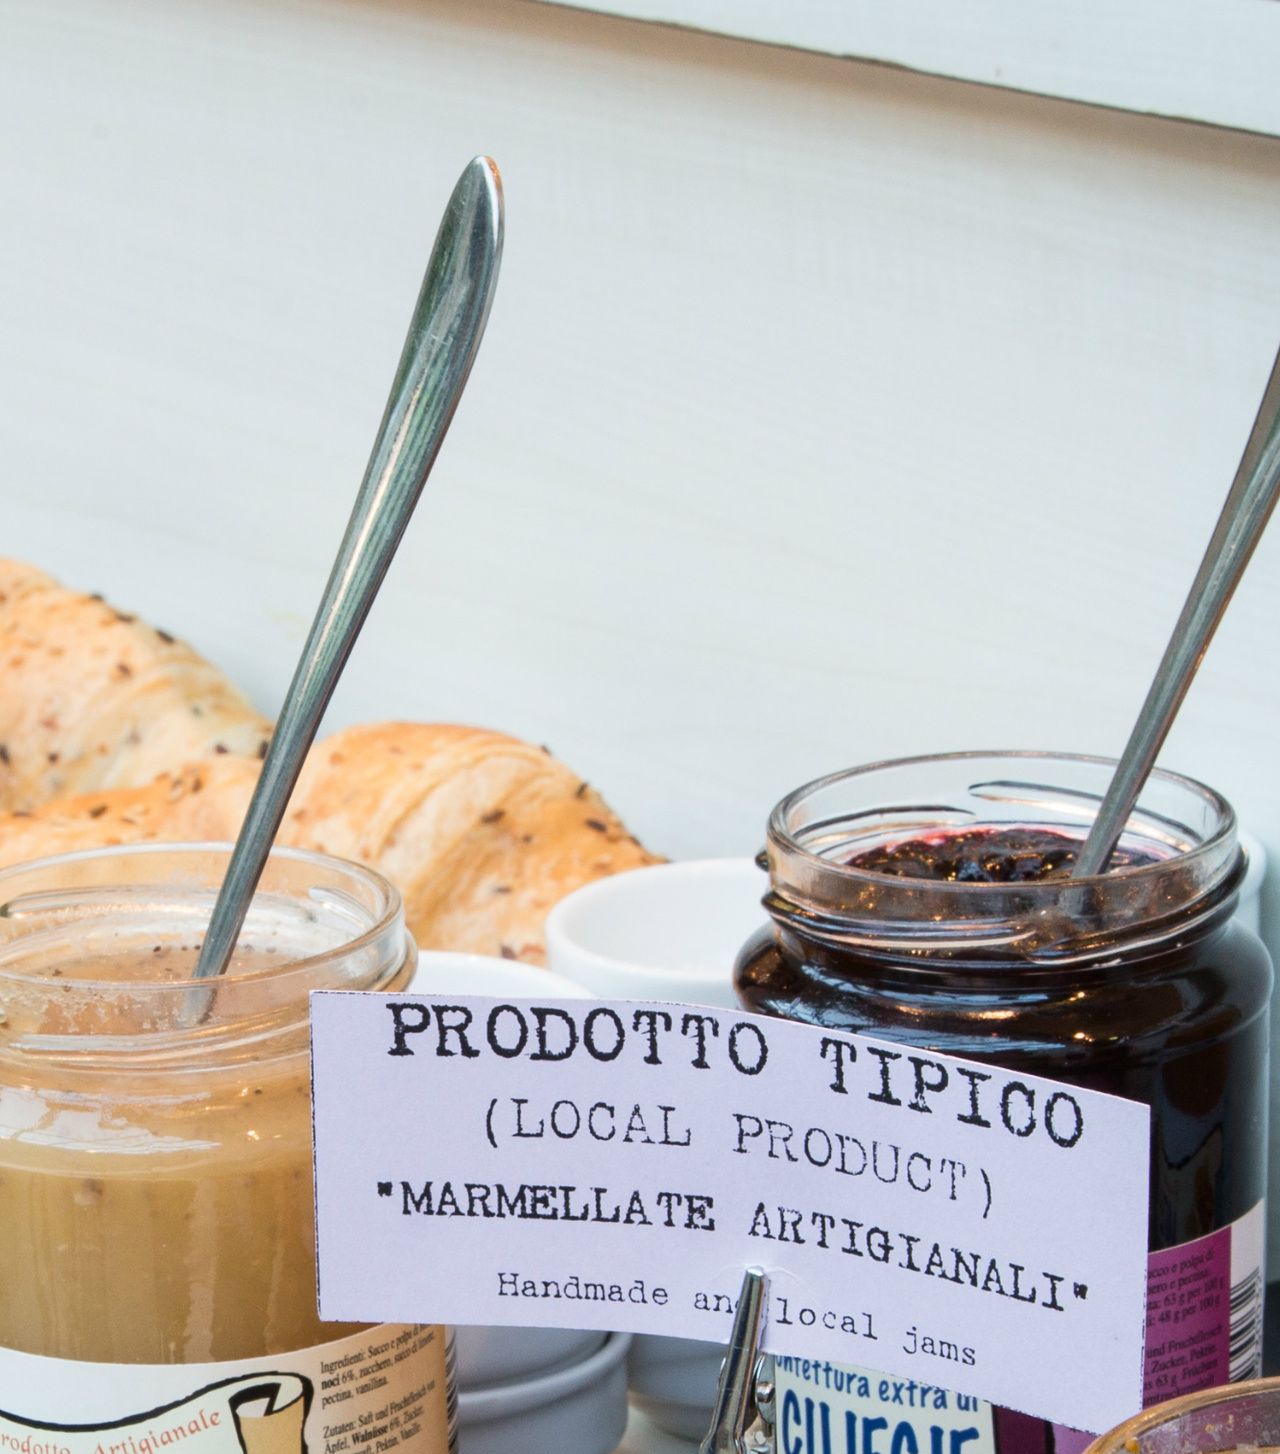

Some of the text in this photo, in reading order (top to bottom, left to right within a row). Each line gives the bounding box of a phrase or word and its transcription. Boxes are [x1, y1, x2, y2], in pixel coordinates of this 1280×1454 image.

[386, 1003, 1083, 1148] PRODOTTO TIPICO
[486, 1098, 992, 1218] (LOCAL PRODUCT)
[377, 1181, 1088, 1311] "MARMELLATE ARTIGIANALI"
[498, 1272, 977, 1366] Handmade an local jams
[879, 1379, 948, 1410] extra
